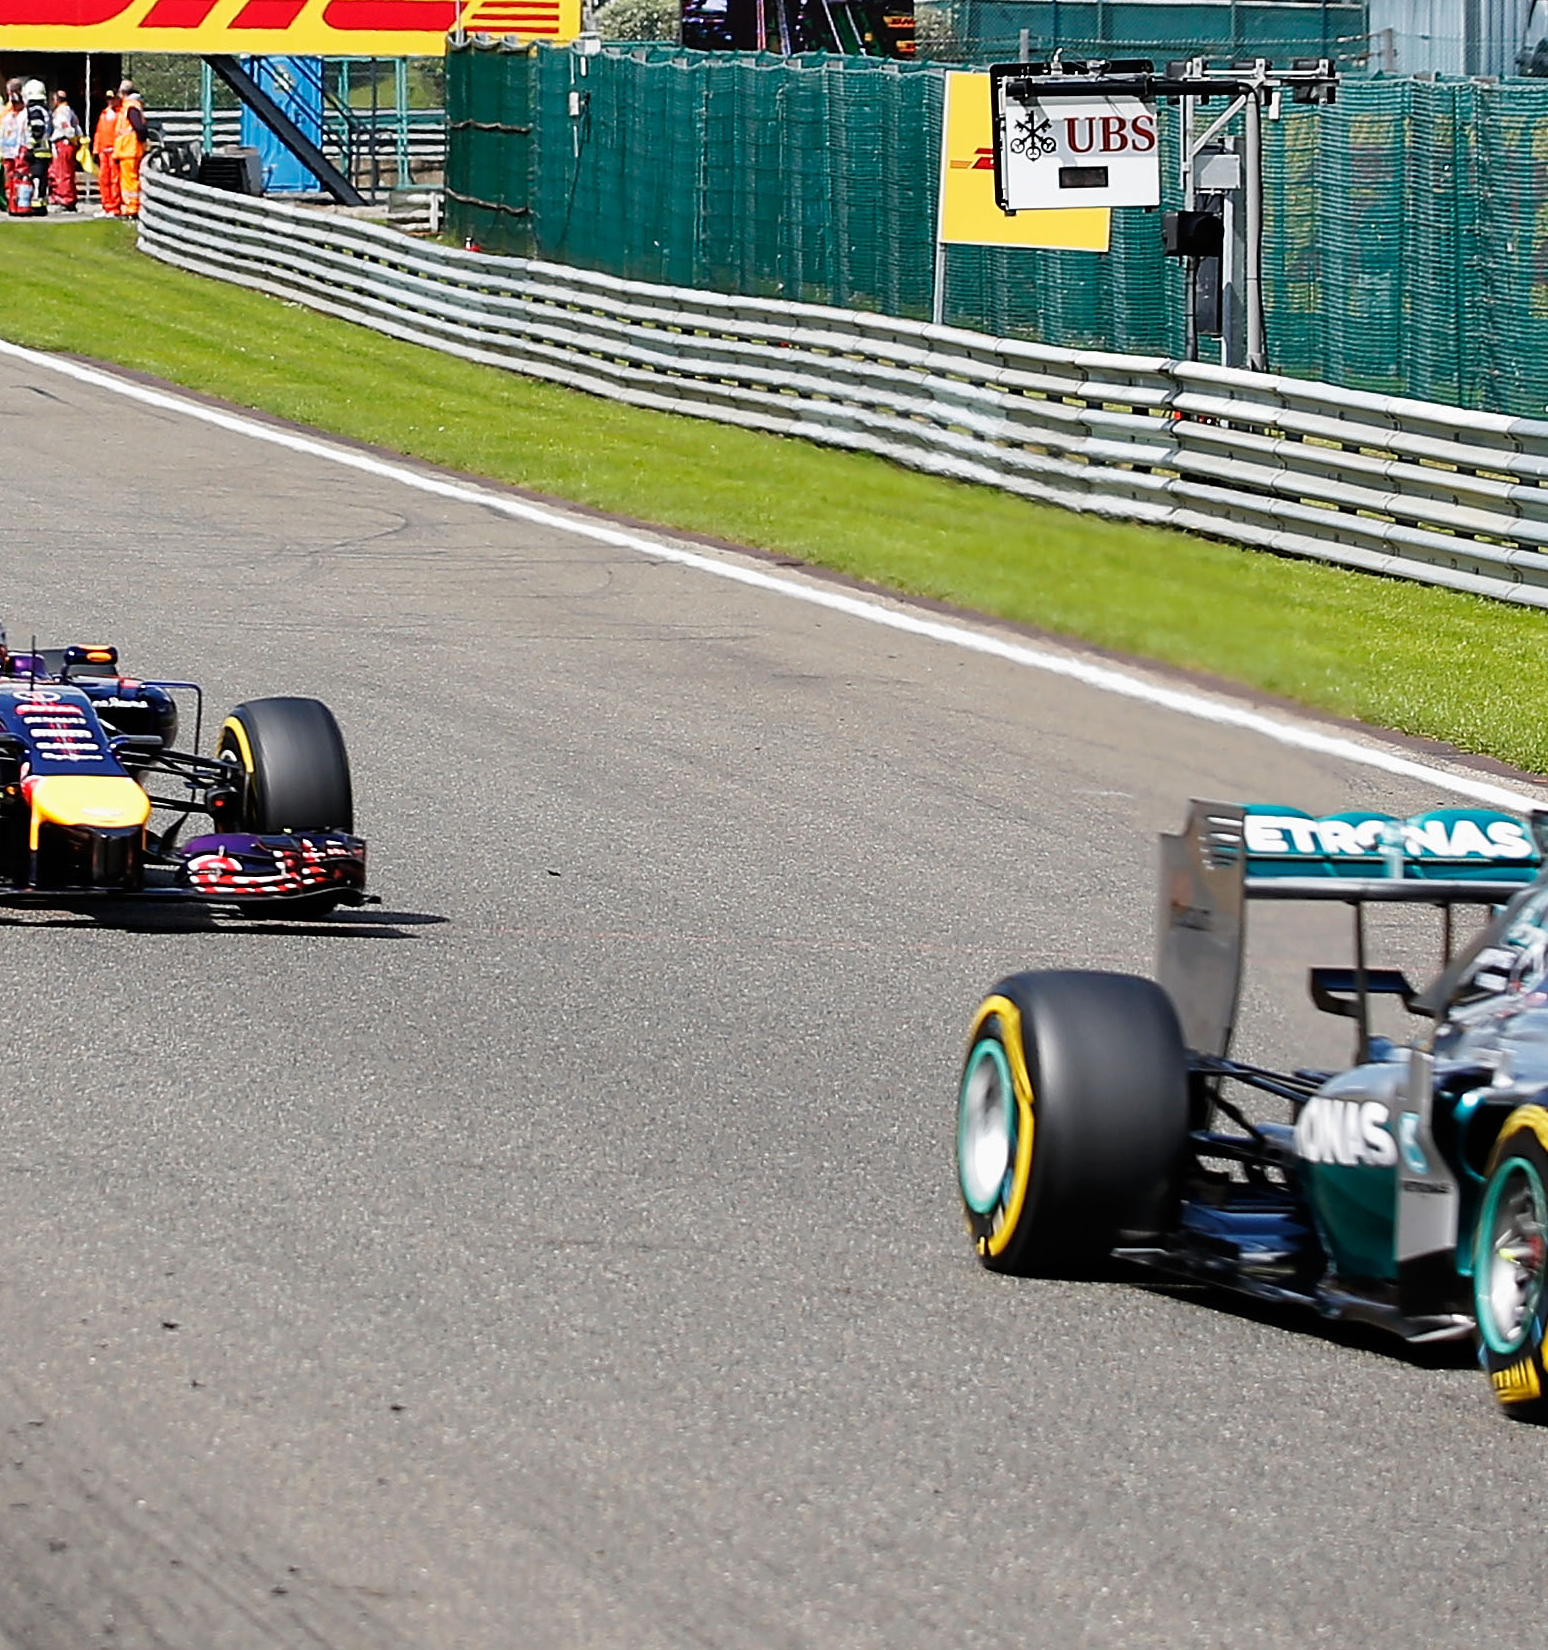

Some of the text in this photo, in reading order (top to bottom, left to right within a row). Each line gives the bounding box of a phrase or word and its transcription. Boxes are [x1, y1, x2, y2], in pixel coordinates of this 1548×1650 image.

[1064, 115, 1155, 153] UBS
[1244, 814, 1532, 858] ETRONAS
[1295, 1097, 1398, 1166] ONAS
